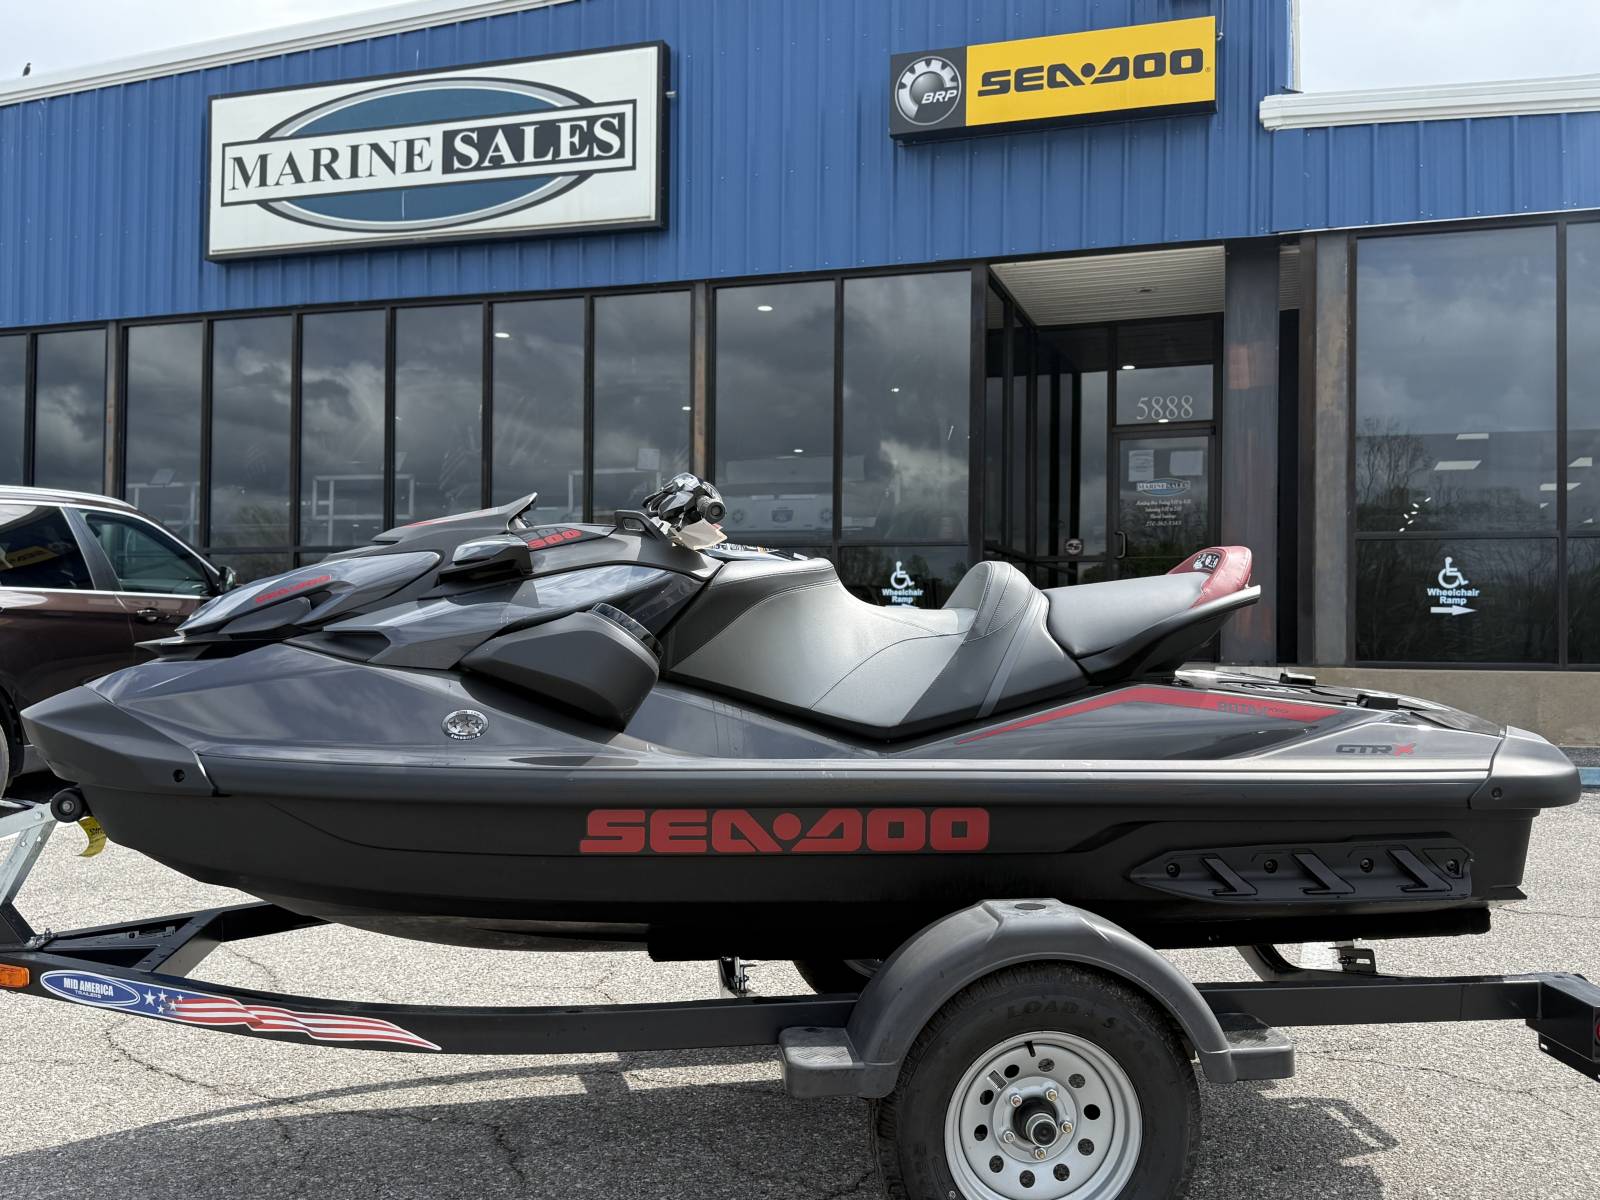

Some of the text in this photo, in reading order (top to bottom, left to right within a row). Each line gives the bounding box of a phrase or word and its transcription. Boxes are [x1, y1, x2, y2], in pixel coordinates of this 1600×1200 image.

[921, 89, 958, 104] BRP
[228, 115, 623, 191] MARINE SALES
[1137, 395, 1193, 419] 5888
[882, 588, 923, 596] Wheelchair
[1427, 588, 1479, 596] Wheelchair
[1440, 597, 1467, 605] Ramp
[63, 977, 114, 996] MID AMERICA
